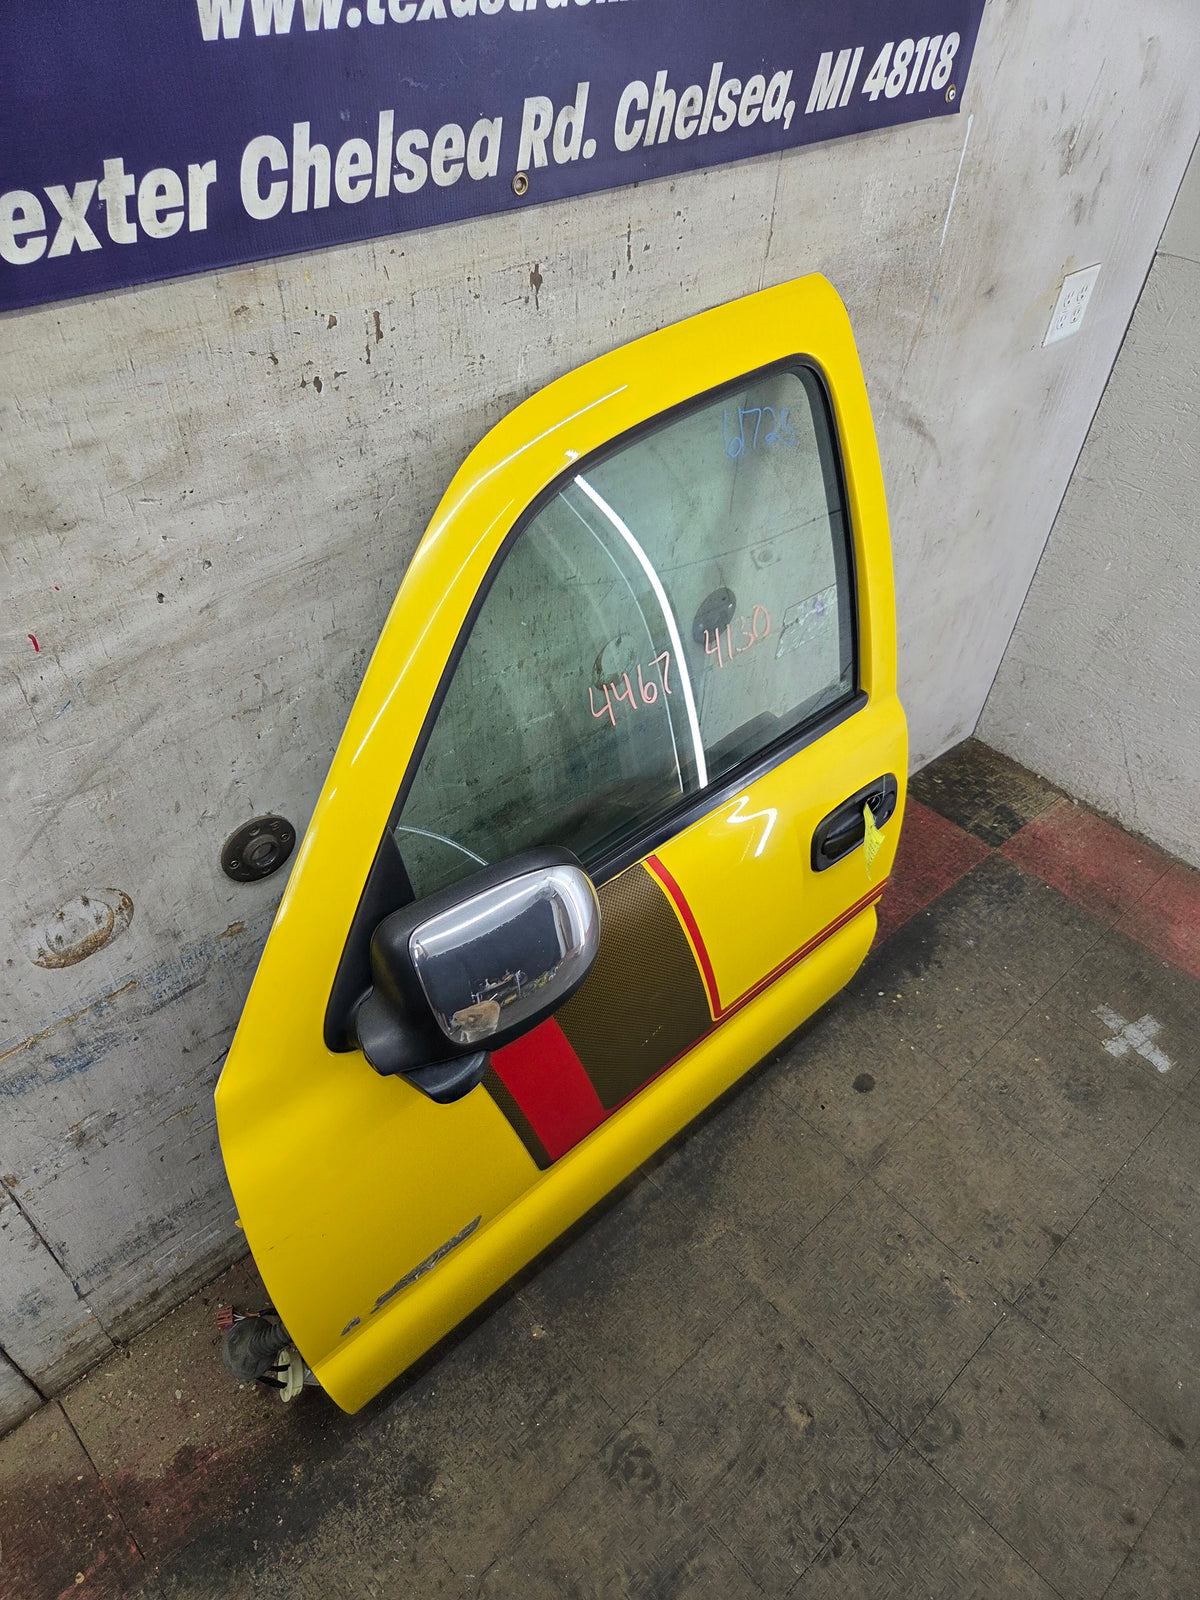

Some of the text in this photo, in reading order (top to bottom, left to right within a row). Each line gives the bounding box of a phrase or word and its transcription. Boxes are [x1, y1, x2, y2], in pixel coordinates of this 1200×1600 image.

[0, 31, 961, 265] exter Chelsea Rd. Chelsea, MI 48118
[589, 605, 771, 726] 4467 4130
